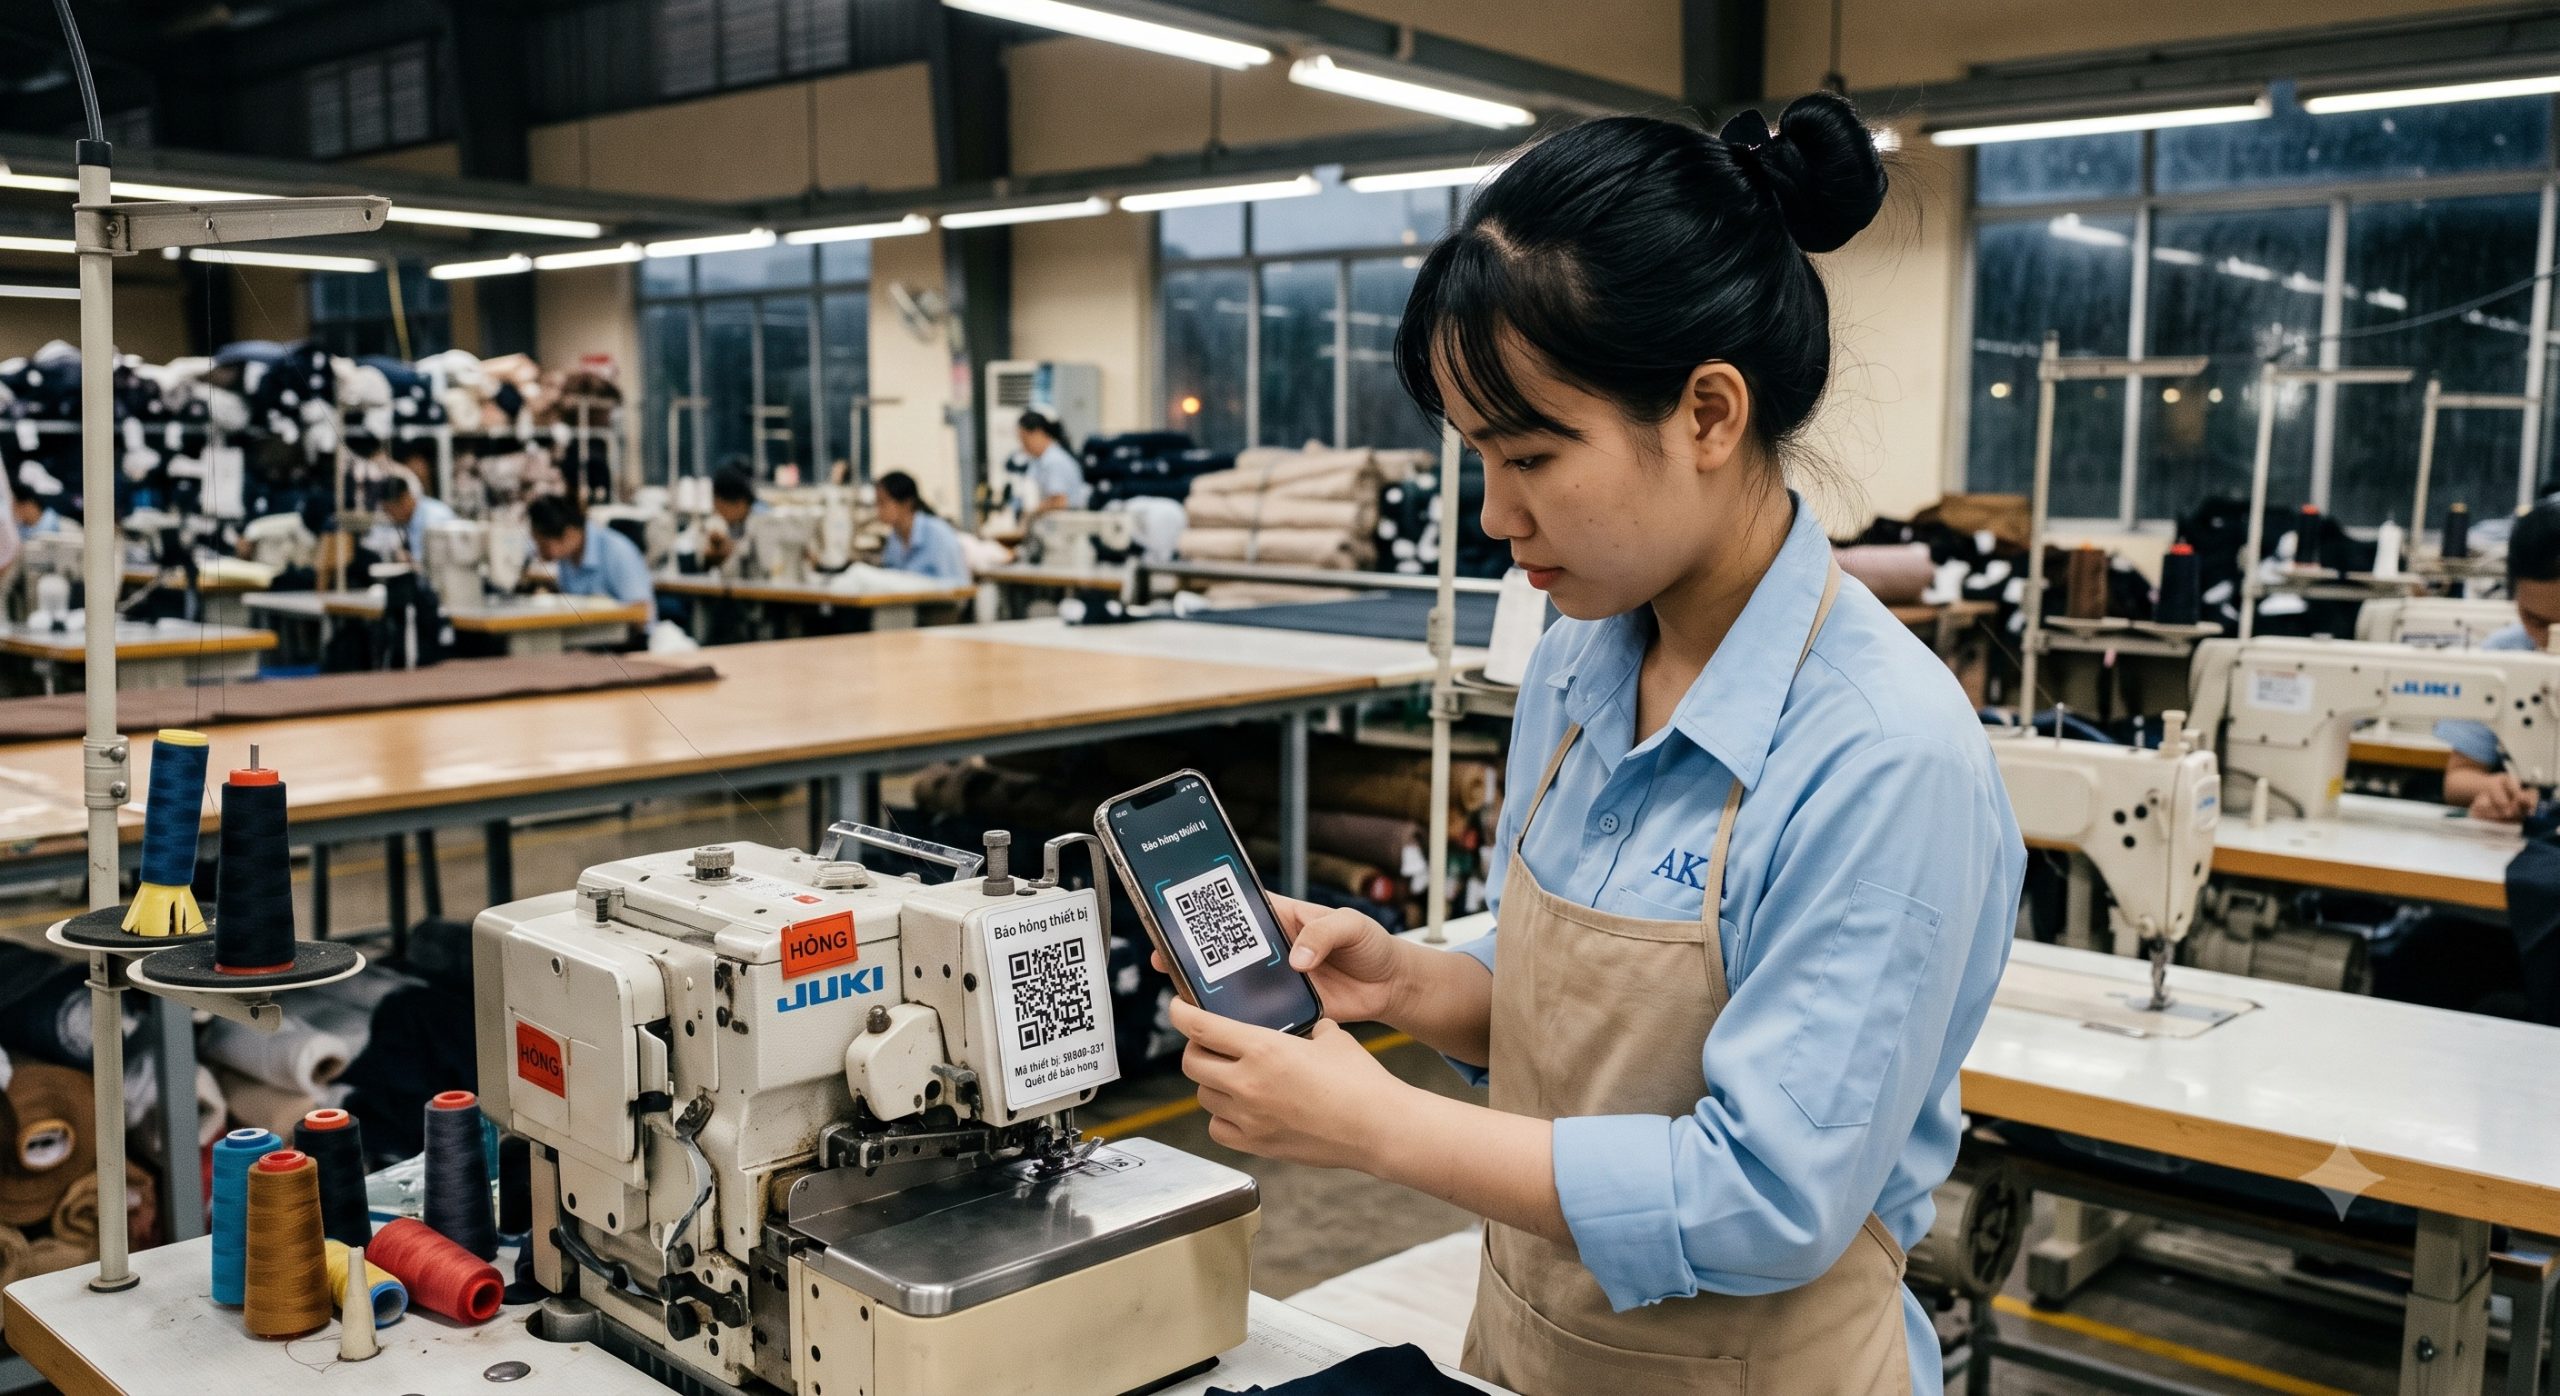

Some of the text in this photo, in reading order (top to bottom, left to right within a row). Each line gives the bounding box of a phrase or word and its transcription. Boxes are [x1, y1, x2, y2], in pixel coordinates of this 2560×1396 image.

[2391, 680, 2461, 699] JUKI
[1651, 848, 1727, 900] AK
[1049, 908, 1076, 927] thiết
[1077, 907, 1088, 922] bị
[777, 966, 884, 1013] JUKI
